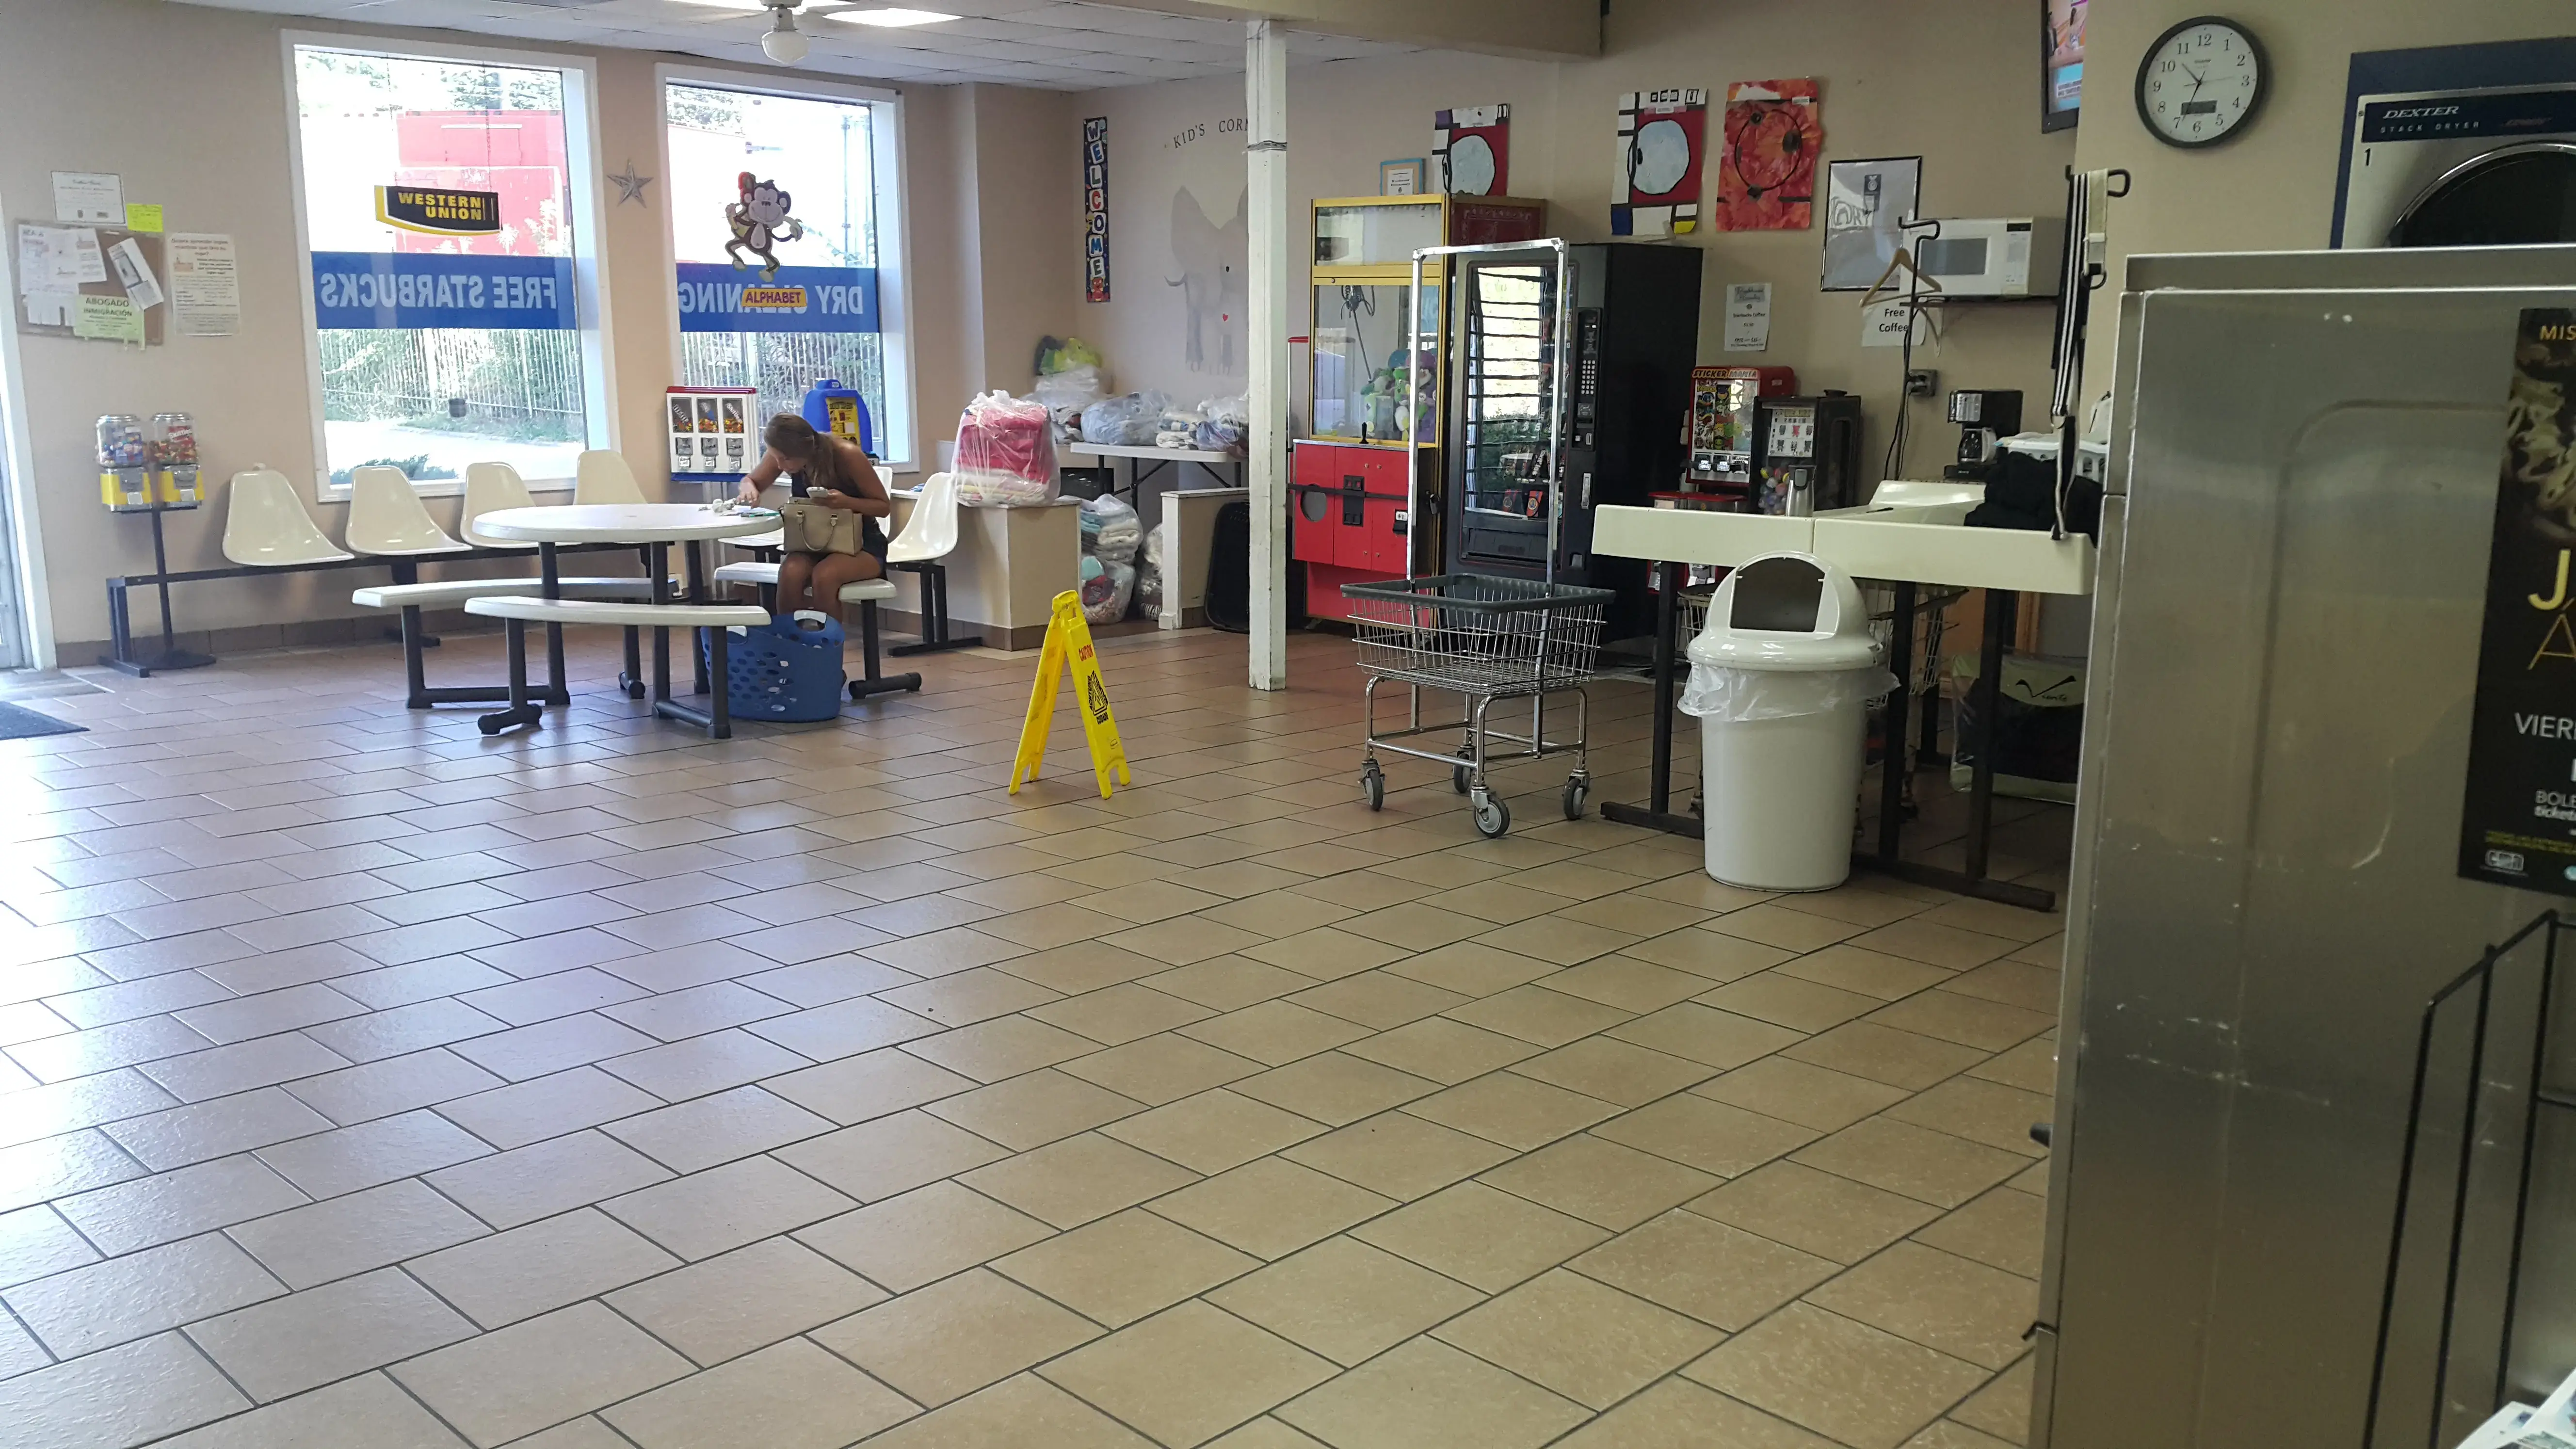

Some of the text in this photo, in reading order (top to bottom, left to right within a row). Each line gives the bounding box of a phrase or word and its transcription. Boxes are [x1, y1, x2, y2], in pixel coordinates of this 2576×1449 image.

[2197, 33, 2212, 46] 12
[2224, 39, 2230, 51] 1
[2177, 42, 2190, 54] 11
[2161, 60, 2176, 72] 10
[2236, 54, 2245, 66] 2
[2154, 80, 2161, 92] 9
[2241, 75, 2250, 87] 3
[2157, 101, 2166, 113] 8
[2232, 97, 2239, 108] 4
[2383, 105, 2459, 119] DEXTER
[2173, 116, 2181, 129] 7
[2215, 113, 2223, 126] 5
[1173, 117, 1248, 149] KID'S COR
[2192, 121, 2201, 133] 6
[2380, 121, 2480, 133] STACK DRYER
[2364, 148, 2371, 166] 1
[398, 192, 482, 209] WESTERN
[1087, 122, 1105, 276] WELCOME
[425, 206, 482, 220] UNION
[86, 297, 129, 307] ABOGADO
[745, 291, 801, 304] ALPHABET
[1884, 308, 1905, 317] Free
[1879, 322, 1909, 333] Coffee
[1693, 370, 1727, 378] STICKER
[1079, 644, 1094, 662] CAUTION
[2514, 711, 2576, 741] VIER
